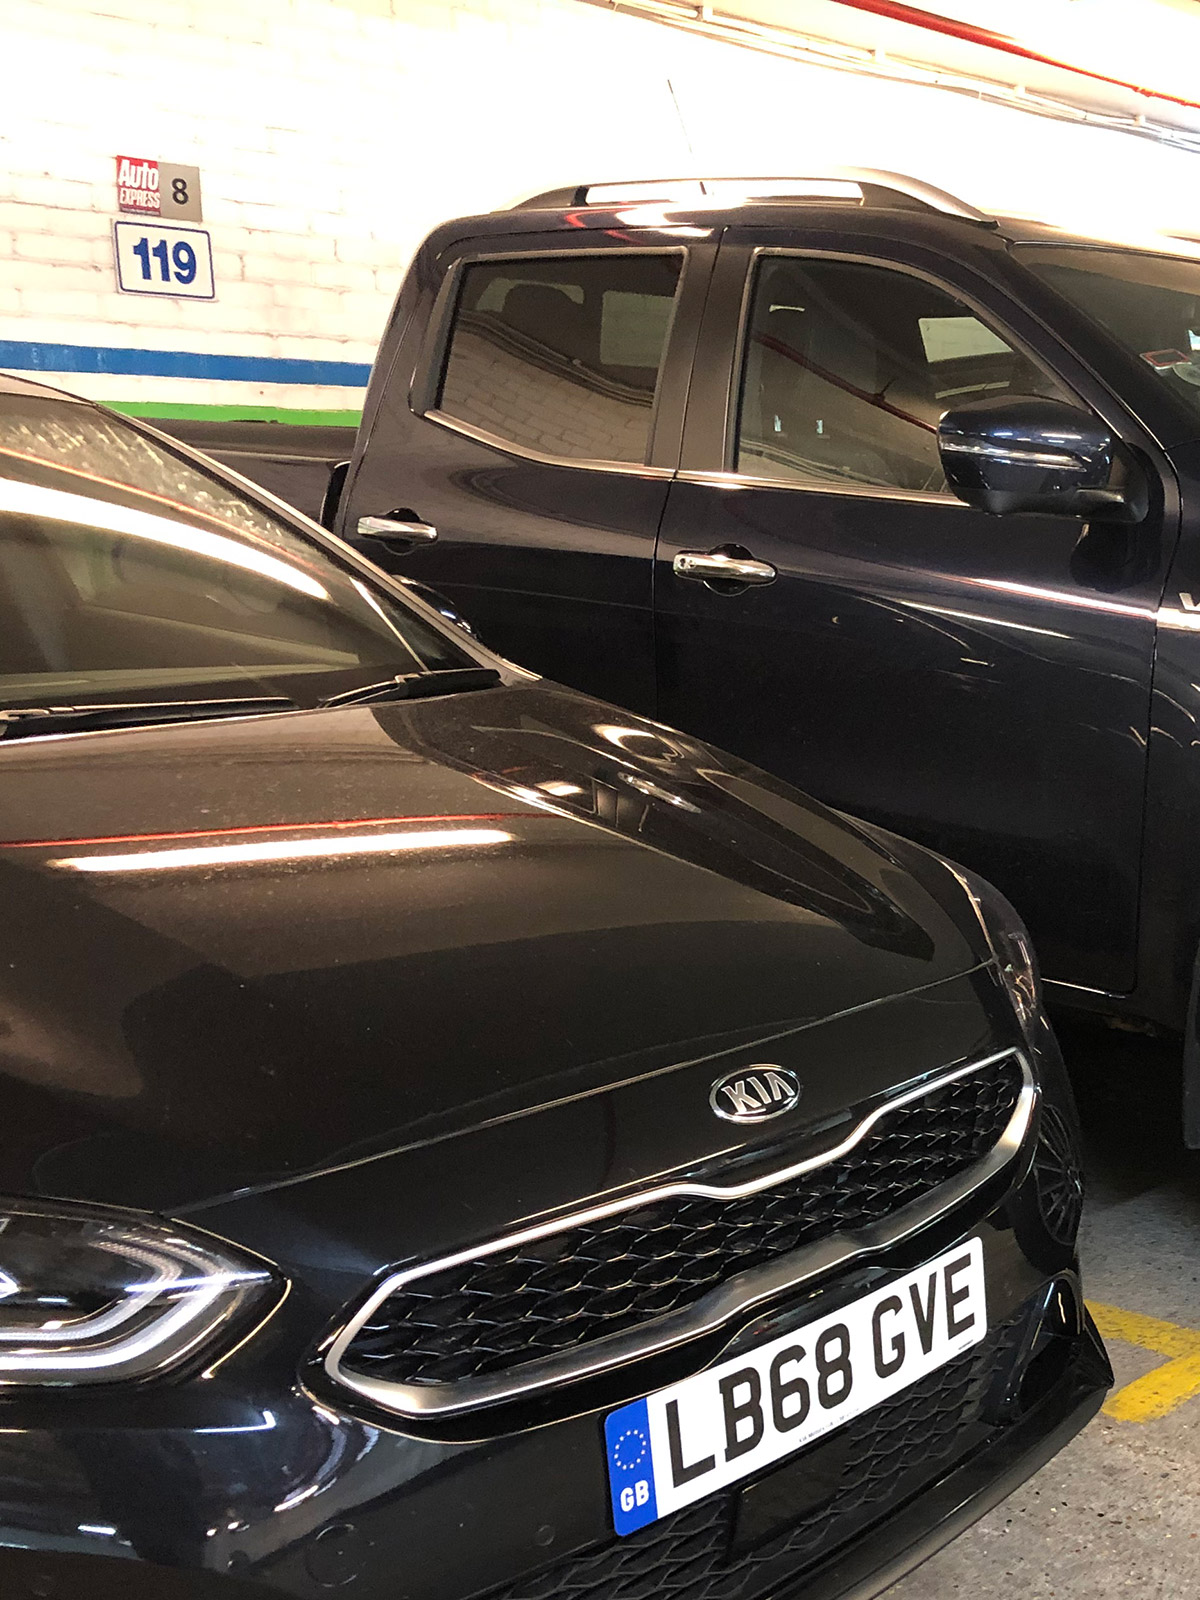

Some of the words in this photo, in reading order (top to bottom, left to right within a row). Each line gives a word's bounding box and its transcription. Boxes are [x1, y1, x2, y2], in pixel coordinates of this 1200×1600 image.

[119, 187, 161, 209] EXPRESS
[171, 178, 189, 205] 8
[133, 237, 197, 285] 119
[720, 1071, 796, 1116] KIA
[665, 1322, 853, 1488] LB68
[871, 1252, 976, 1379] GVE
[619, 1479, 650, 1512] GB
